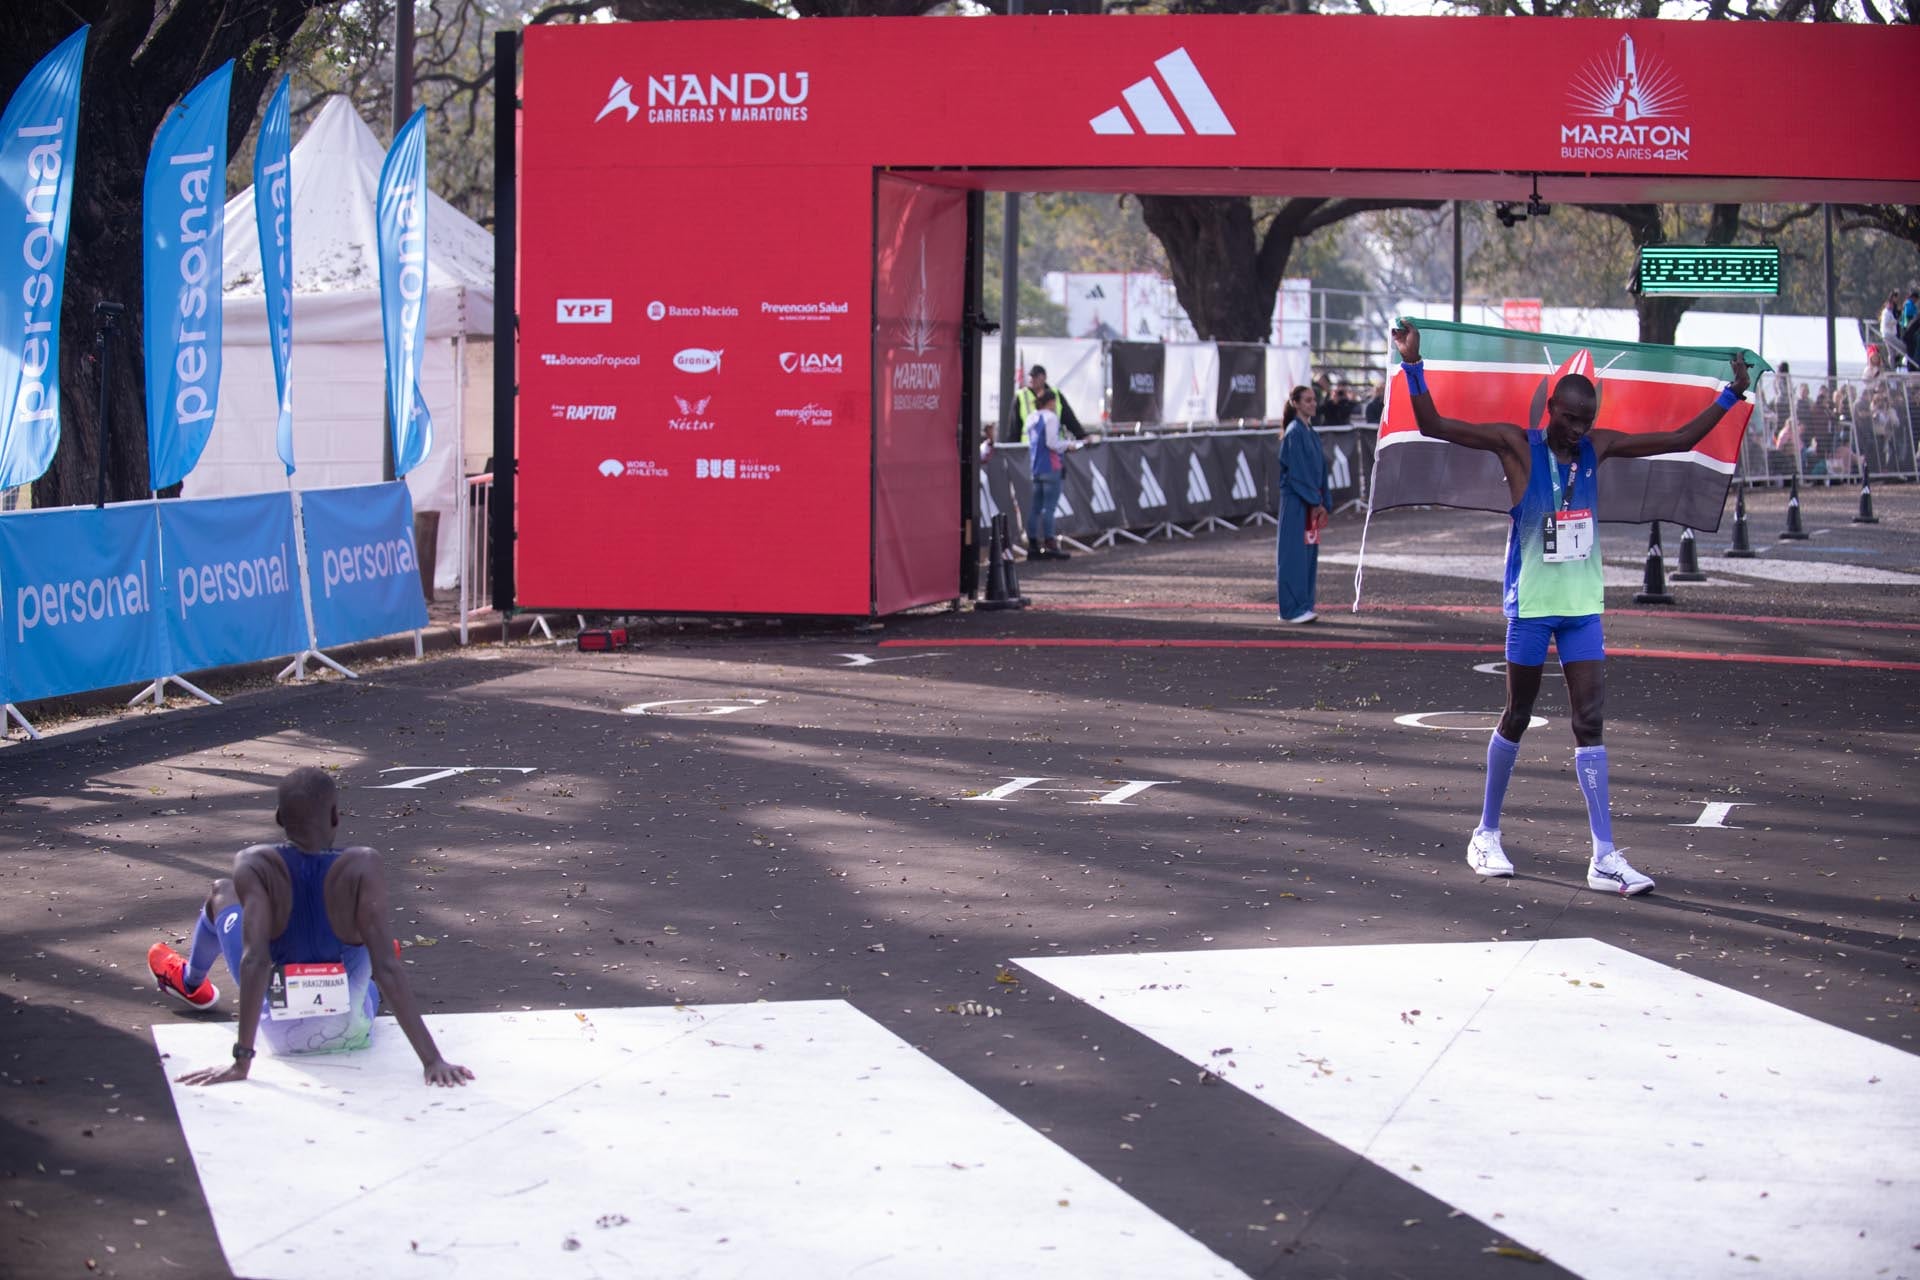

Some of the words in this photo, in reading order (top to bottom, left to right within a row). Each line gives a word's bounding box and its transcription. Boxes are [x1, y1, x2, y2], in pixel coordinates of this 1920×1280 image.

[648, 108, 714, 123] CARRERAS
[718, 107, 727, 122] Y
[731, 106, 808, 121] MARATONES
[1560, 147, 1613, 160] BUENOS
[17, 116, 64, 424] personal
[170, 144, 214, 425] personal
[563, 304, 606, 318] YPF
[668, 306, 700, 317] Banco
[702, 305, 739, 317] Nación
[819, 302, 848, 313] Salud
[560, 354, 641, 369] BananaTropical
[800, 353, 842, 367] IAM
[893, 362, 941, 390] MARATON
[566, 405, 617, 420] RAPTOR
[626, 460, 655, 468] WORLD
[740, 464, 781, 472] BUENOS
[626, 468, 669, 477] ATHLETICS
[322, 526, 418, 598] personal
[178, 542, 289, 620] personal
[17, 560, 150, 643] personal
